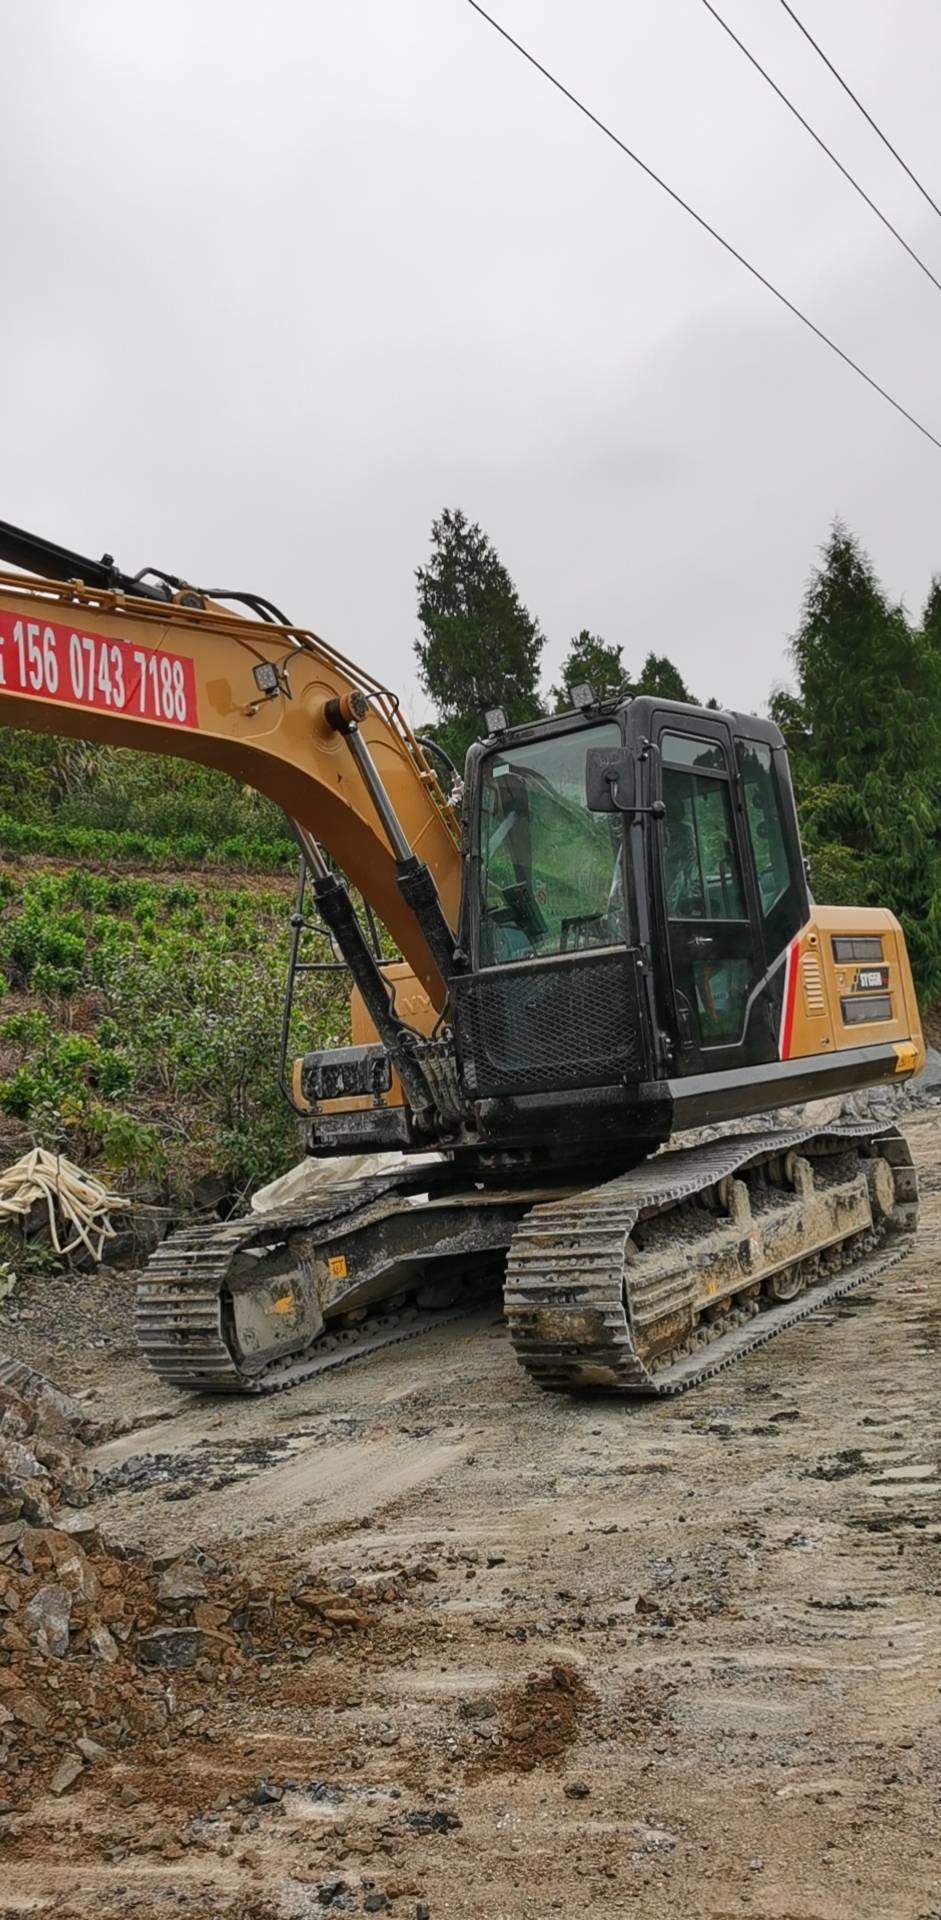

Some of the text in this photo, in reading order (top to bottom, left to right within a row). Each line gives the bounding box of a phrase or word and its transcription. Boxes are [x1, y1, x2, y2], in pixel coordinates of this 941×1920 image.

[13, 620, 59, 693] 156
[70, 633, 125, 708] 0743
[134, 651, 186, 722] 7188
